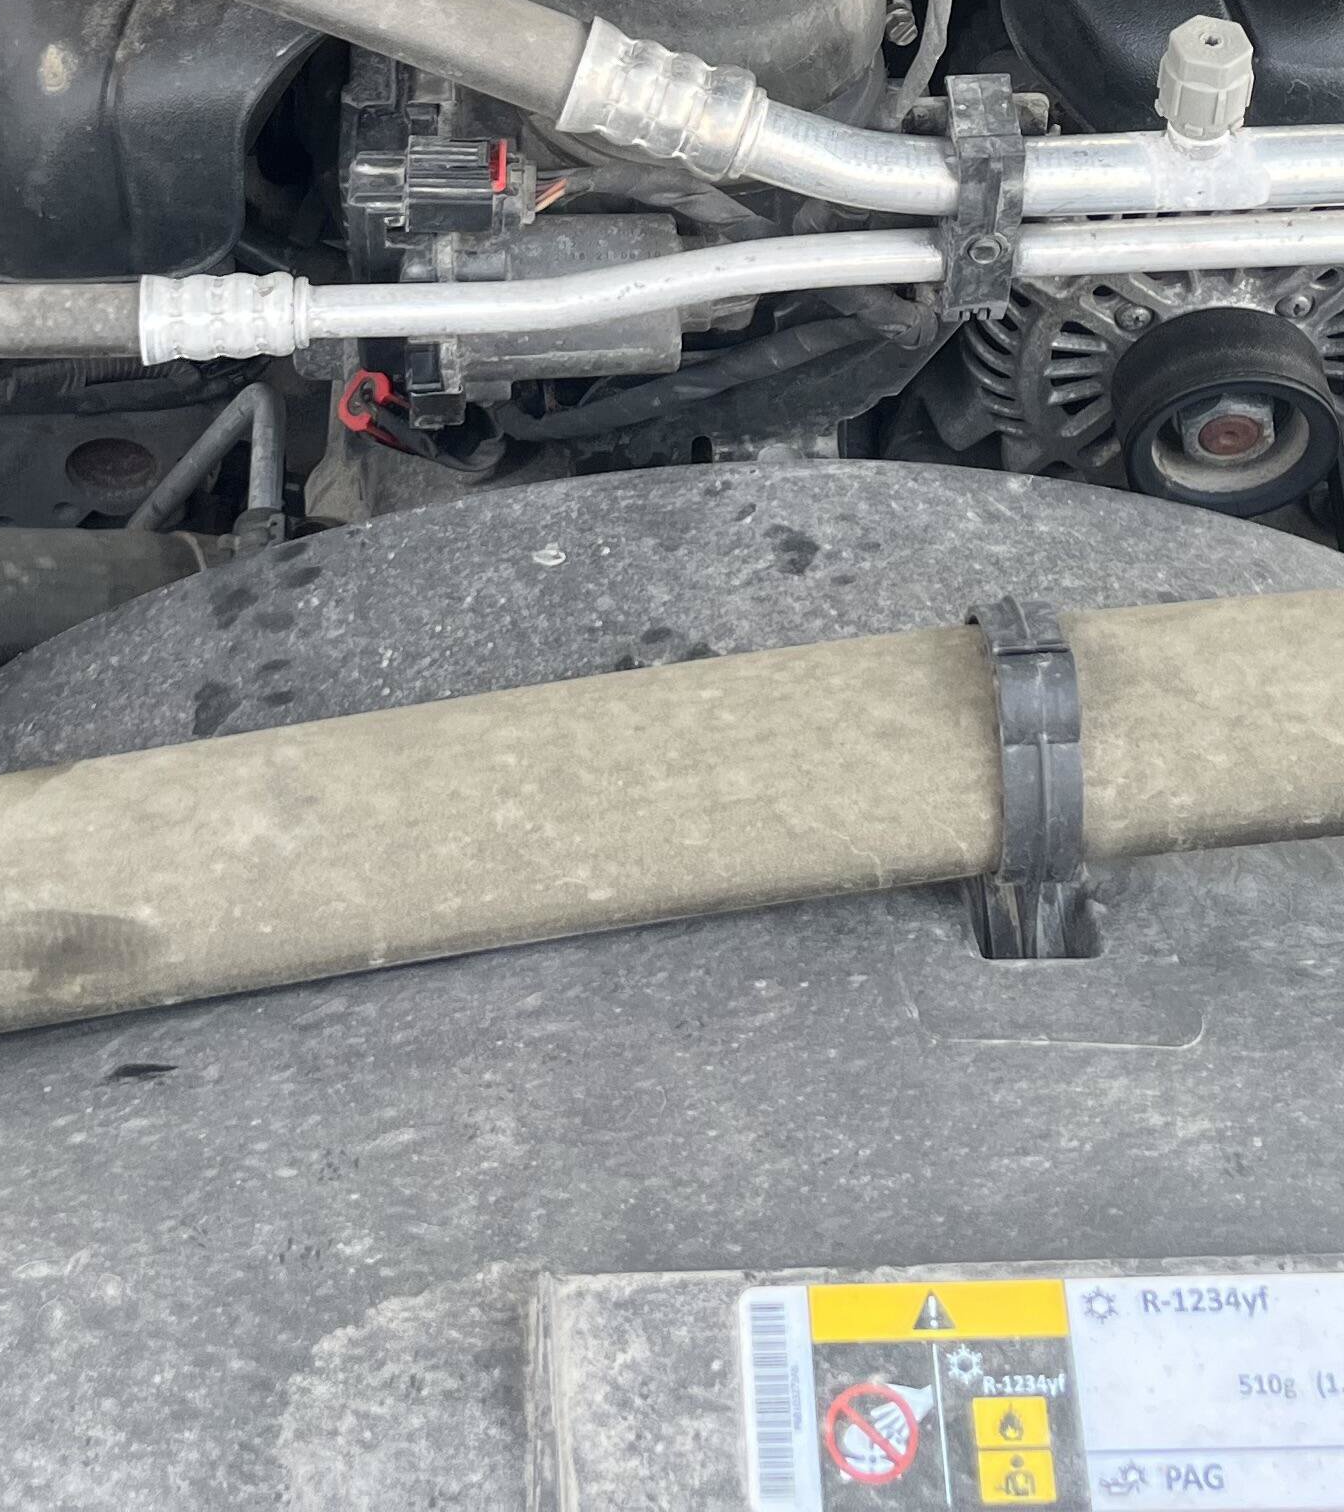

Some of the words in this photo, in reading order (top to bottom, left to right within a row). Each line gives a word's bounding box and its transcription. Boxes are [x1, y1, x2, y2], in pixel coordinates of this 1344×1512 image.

[1142, 1285, 1270, 1317] R-1234yf
[982, 1373, 1066, 1397] R-1234yf
[1239, 1373, 1296, 1399] 510g
[1165, 1464, 1225, 1491] PAG
